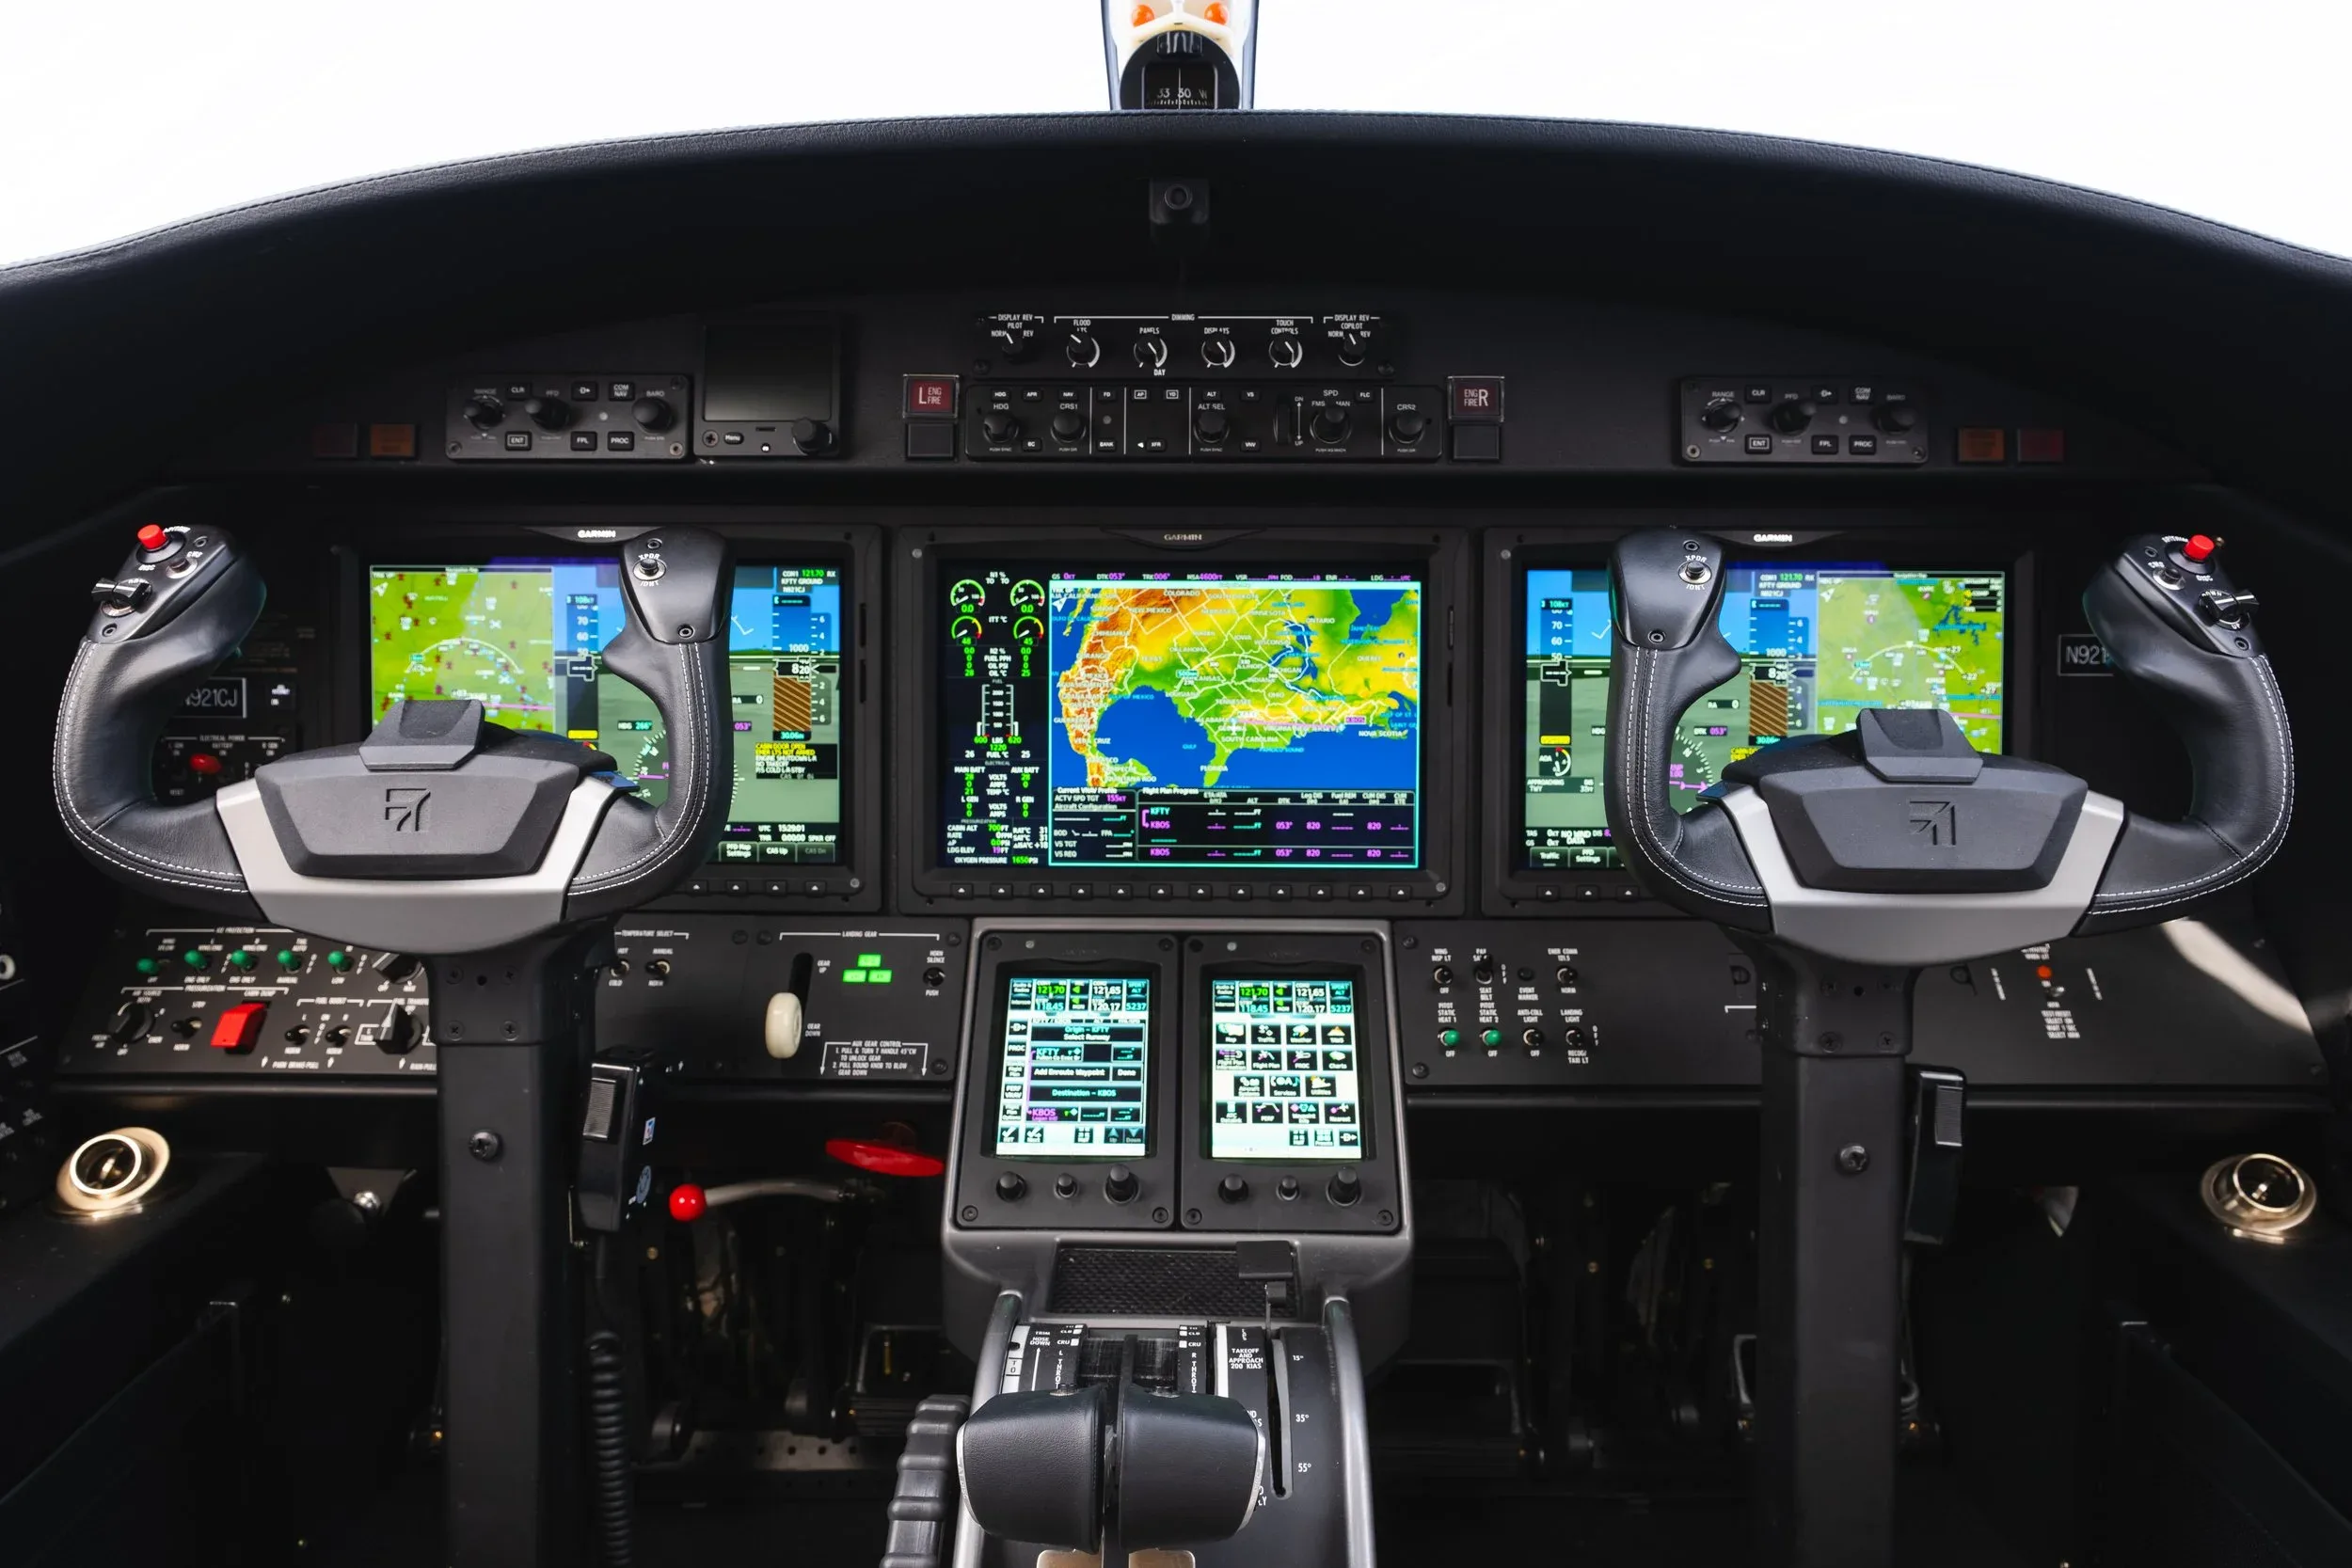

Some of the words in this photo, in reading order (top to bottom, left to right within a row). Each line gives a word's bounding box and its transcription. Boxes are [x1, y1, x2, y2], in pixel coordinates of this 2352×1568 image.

[997, 313, 1021, 322] DISPLAY
[1022, 313, 1033, 322] REV
[1341, 322, 1363, 330] COPILOT
[928, 387, 942, 395] ENG
[1464, 388, 1478, 397] ENG
[918, 387, 927, 404] L
[1478, 388, 1488, 406] R
[927, 396, 942, 404] FIRE
[1464, 398, 1478, 406] FIRE
[724, 434, 741, 442] Menu
[577, 530, 616, 538] GARMIN
[1164, 532, 1202, 541] GARMIN
[638, 552, 660, 561] XPDR
[1685, 554, 1708, 562] XPDR
[577, 616, 589, 625] 70
[1551, 621, 1563, 629] 70
[577, 632, 589, 641] 60
[1551, 637, 1563, 645] 60
[789, 643, 809, 653] 1000
[2066, 644, 2107, 664] N921
[1150, 807, 1170, 816] KFTY
[1150, 848, 1170, 857] KBOS
[1037, 985, 1066, 993] 121.70
[1239, 988, 1268, 996] 121.70
[1126, 1002, 1147, 1010] 5237
[1330, 1005, 1352, 1013] 5237
[1036, 1047, 1060, 1055] KFTY
[1075, 1068, 1106, 1078] Waypoint
[1032, 1107, 1057, 1117] KBOS
[1295, 1414, 1310, 1422] 35°
[1298, 1463, 1311, 1473] 55°
